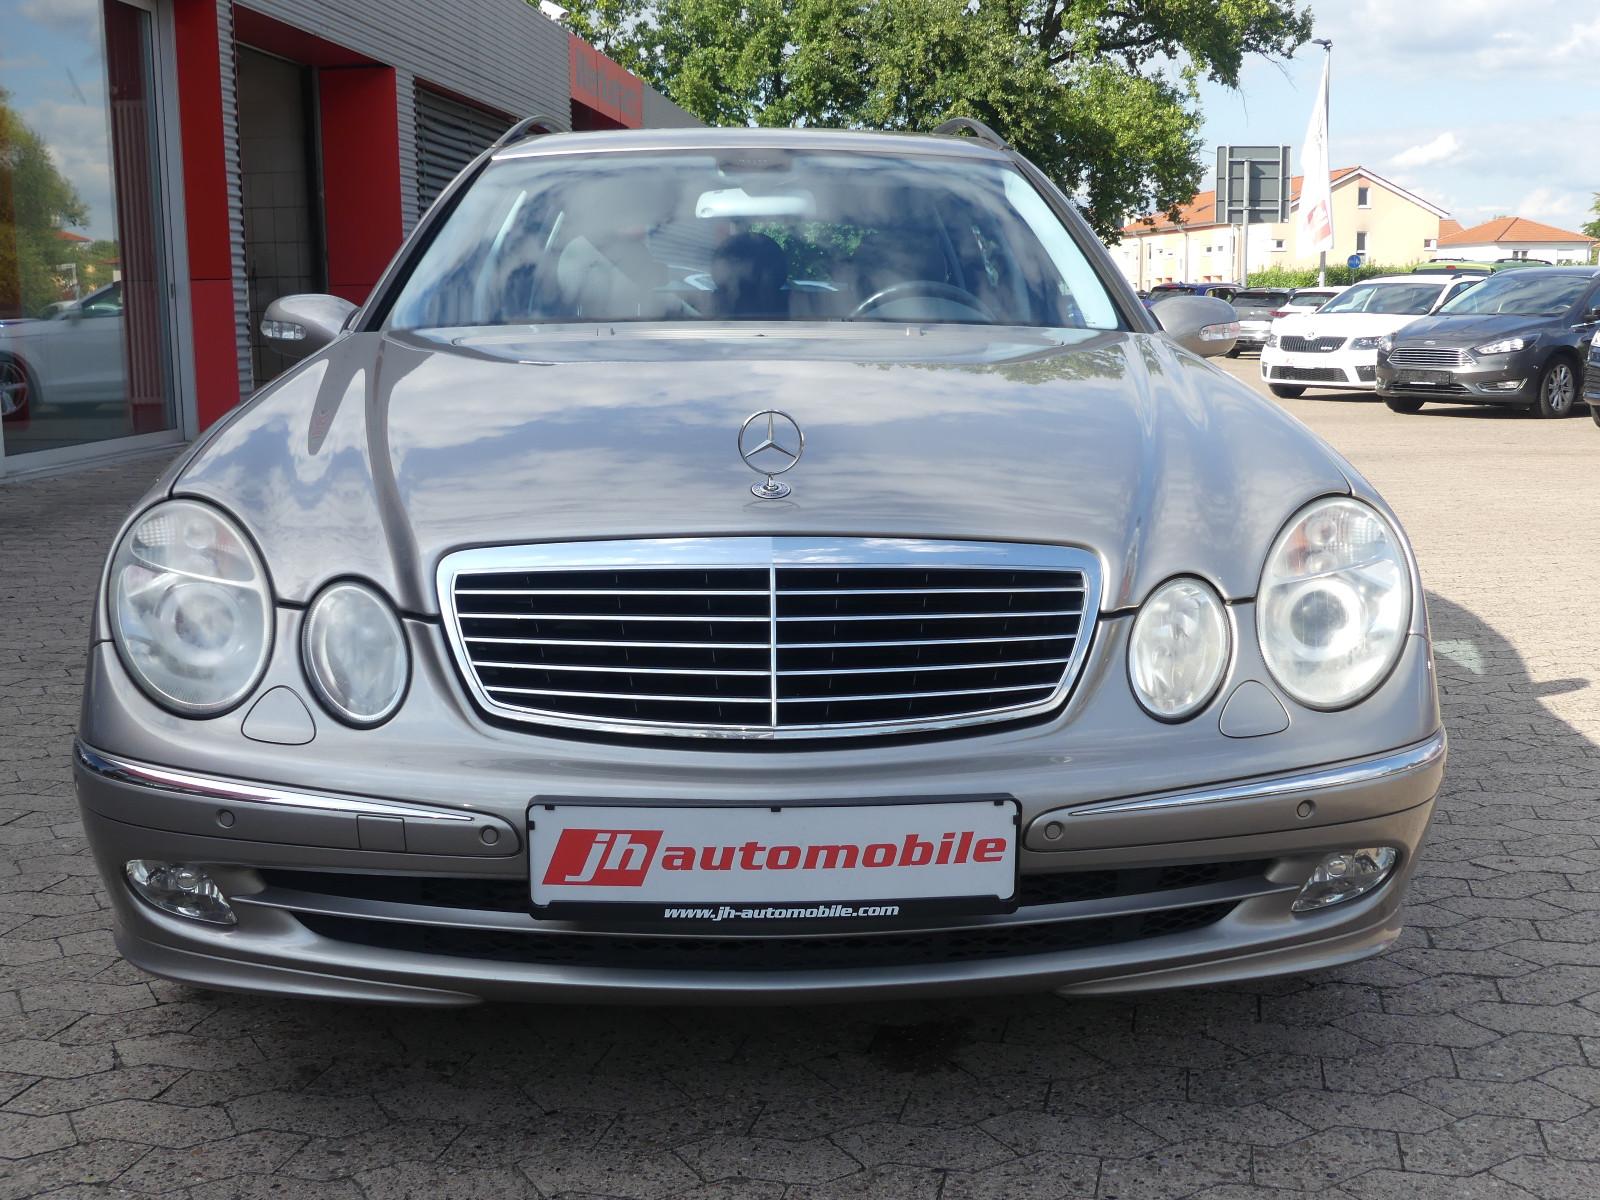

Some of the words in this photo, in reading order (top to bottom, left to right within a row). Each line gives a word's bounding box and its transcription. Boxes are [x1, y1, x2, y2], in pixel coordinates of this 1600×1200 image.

[564, 833, 648, 882] jh
[661, 832, 1007, 871] automobile
[664, 904, 900, 920] www.jh-automobile.com
